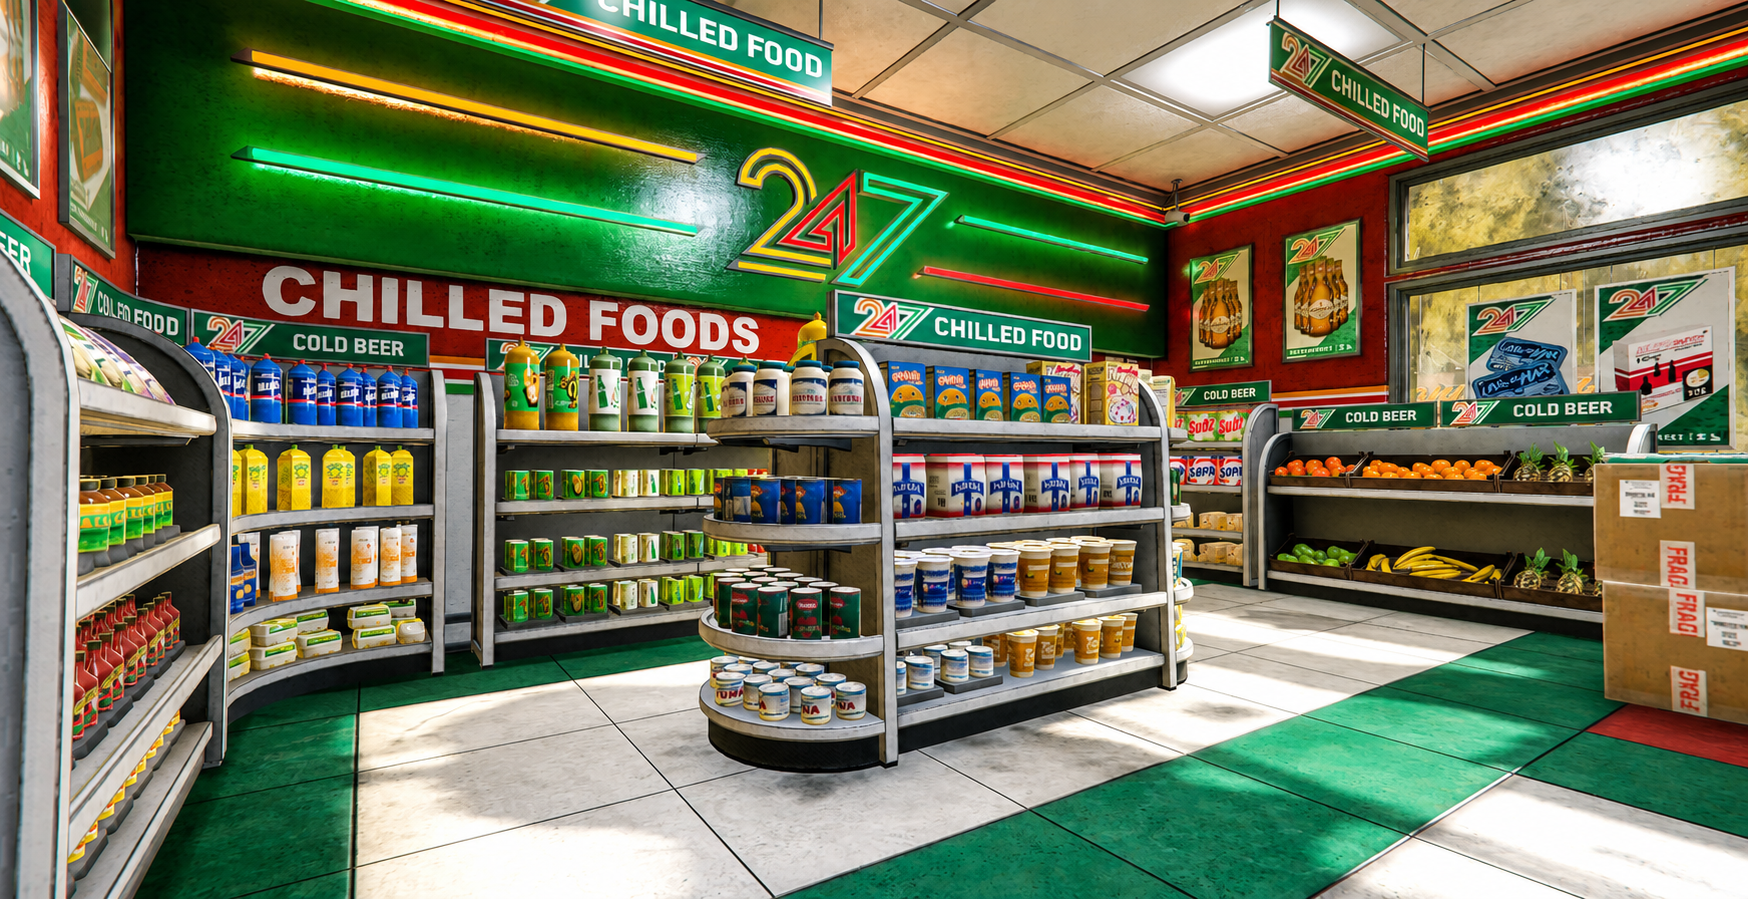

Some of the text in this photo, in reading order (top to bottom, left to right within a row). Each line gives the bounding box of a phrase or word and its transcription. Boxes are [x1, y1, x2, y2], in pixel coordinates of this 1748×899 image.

[748, 33, 823, 78] FOOD
[1331, 69, 1390, 119] CHILLED
[1392, 102, 1425, 138] FOOD
[262, 265, 761, 354] CHILLED FOODS
[293, 333, 348, 353] COLD
[354, 338, 404, 357] BEER
[934, 316, 1026, 345] CHILLED
[1031, 329, 1082, 351] FOOD
[1204, 389, 1229, 401] COLD
[1231, 388, 1256, 398] BEER
[1345, 411, 1379, 423] COLD
[1382, 410, 1417, 422] BEER
[1513, 402, 1560, 418] COLD
[1564, 401, 1613, 415] BEER
